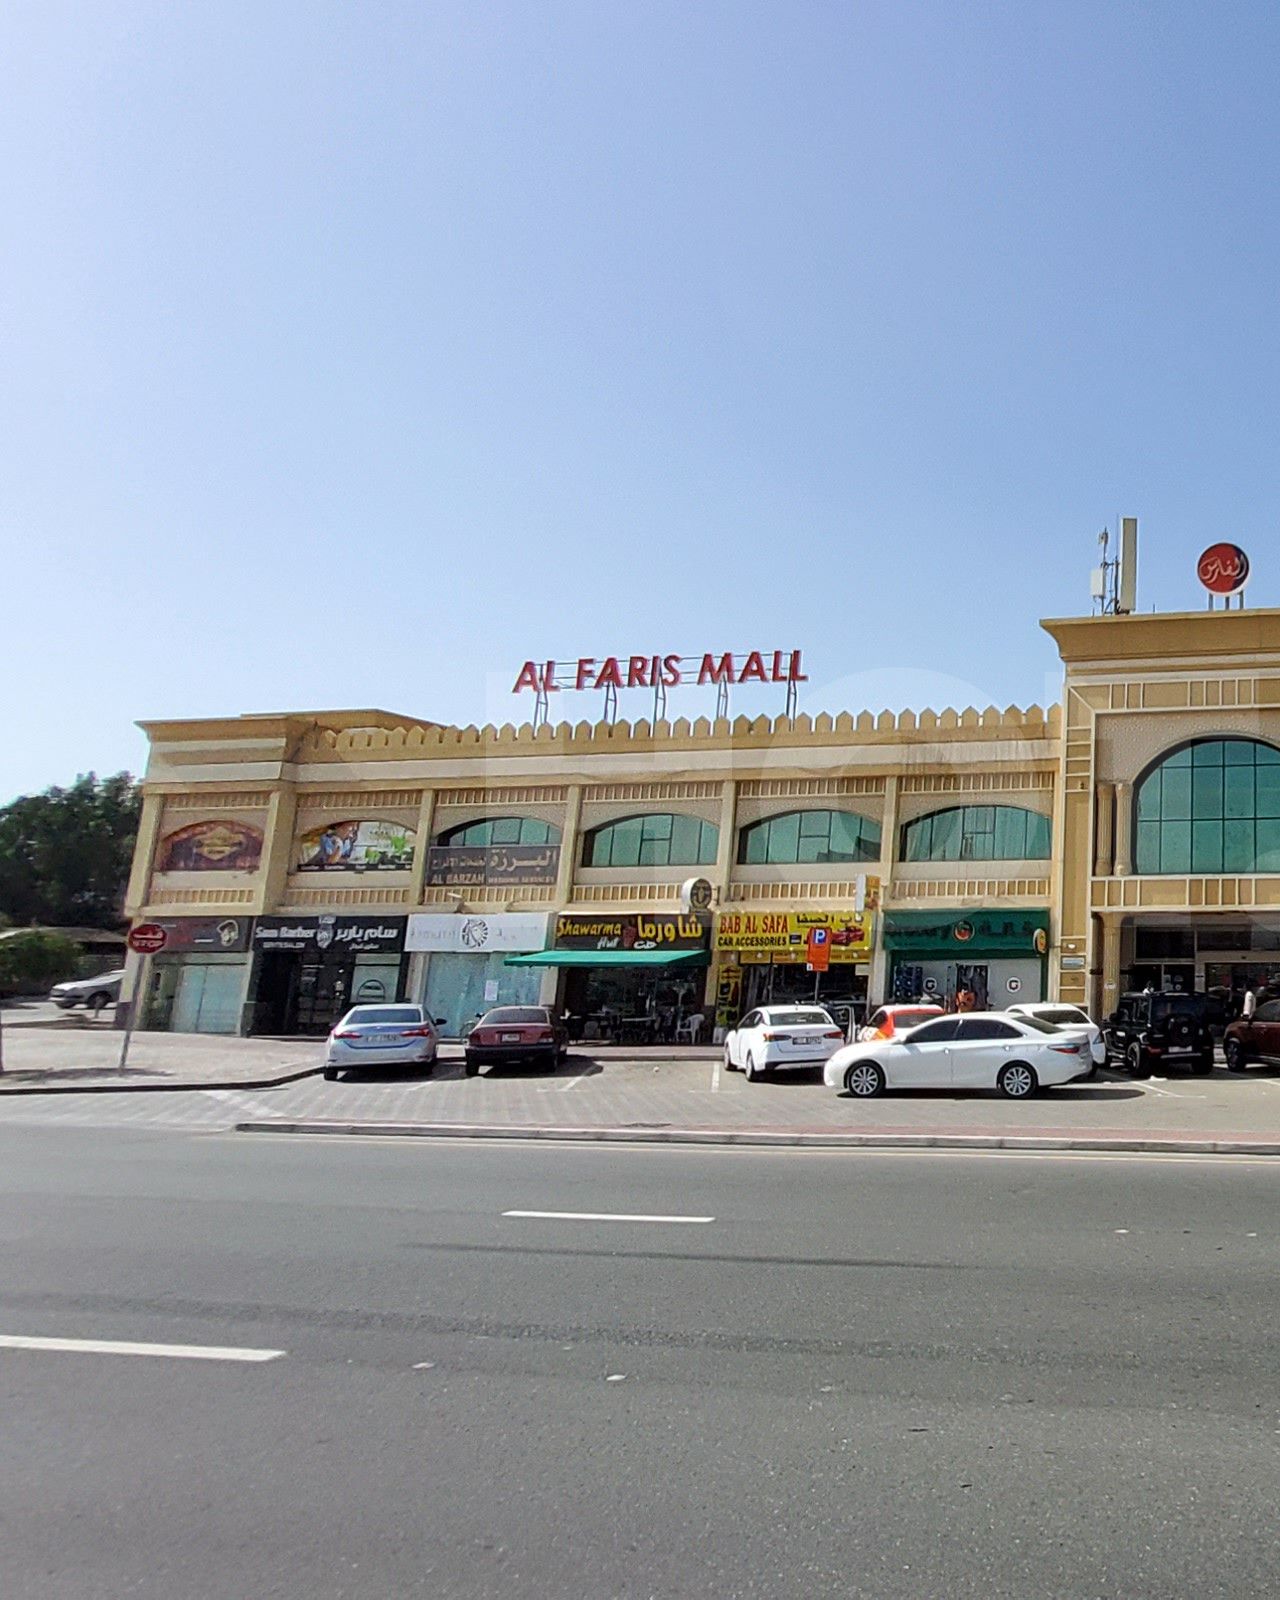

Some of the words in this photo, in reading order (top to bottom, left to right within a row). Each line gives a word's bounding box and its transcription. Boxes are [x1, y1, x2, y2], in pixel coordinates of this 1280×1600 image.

[512, 660, 561, 693] AL
[576, 654, 683, 691] FARIS
[696, 649, 810, 686] MALL
[557, 918, 622, 937] Shawarma
[719, 915, 741, 934] BAB
[744, 915, 758, 934] AL
[762, 914, 789, 934] SAFA
[597, 936, 620, 950] Hut
[718, 936, 734, 947] CAR
[735, 935, 787, 947] ACCESSORIES
